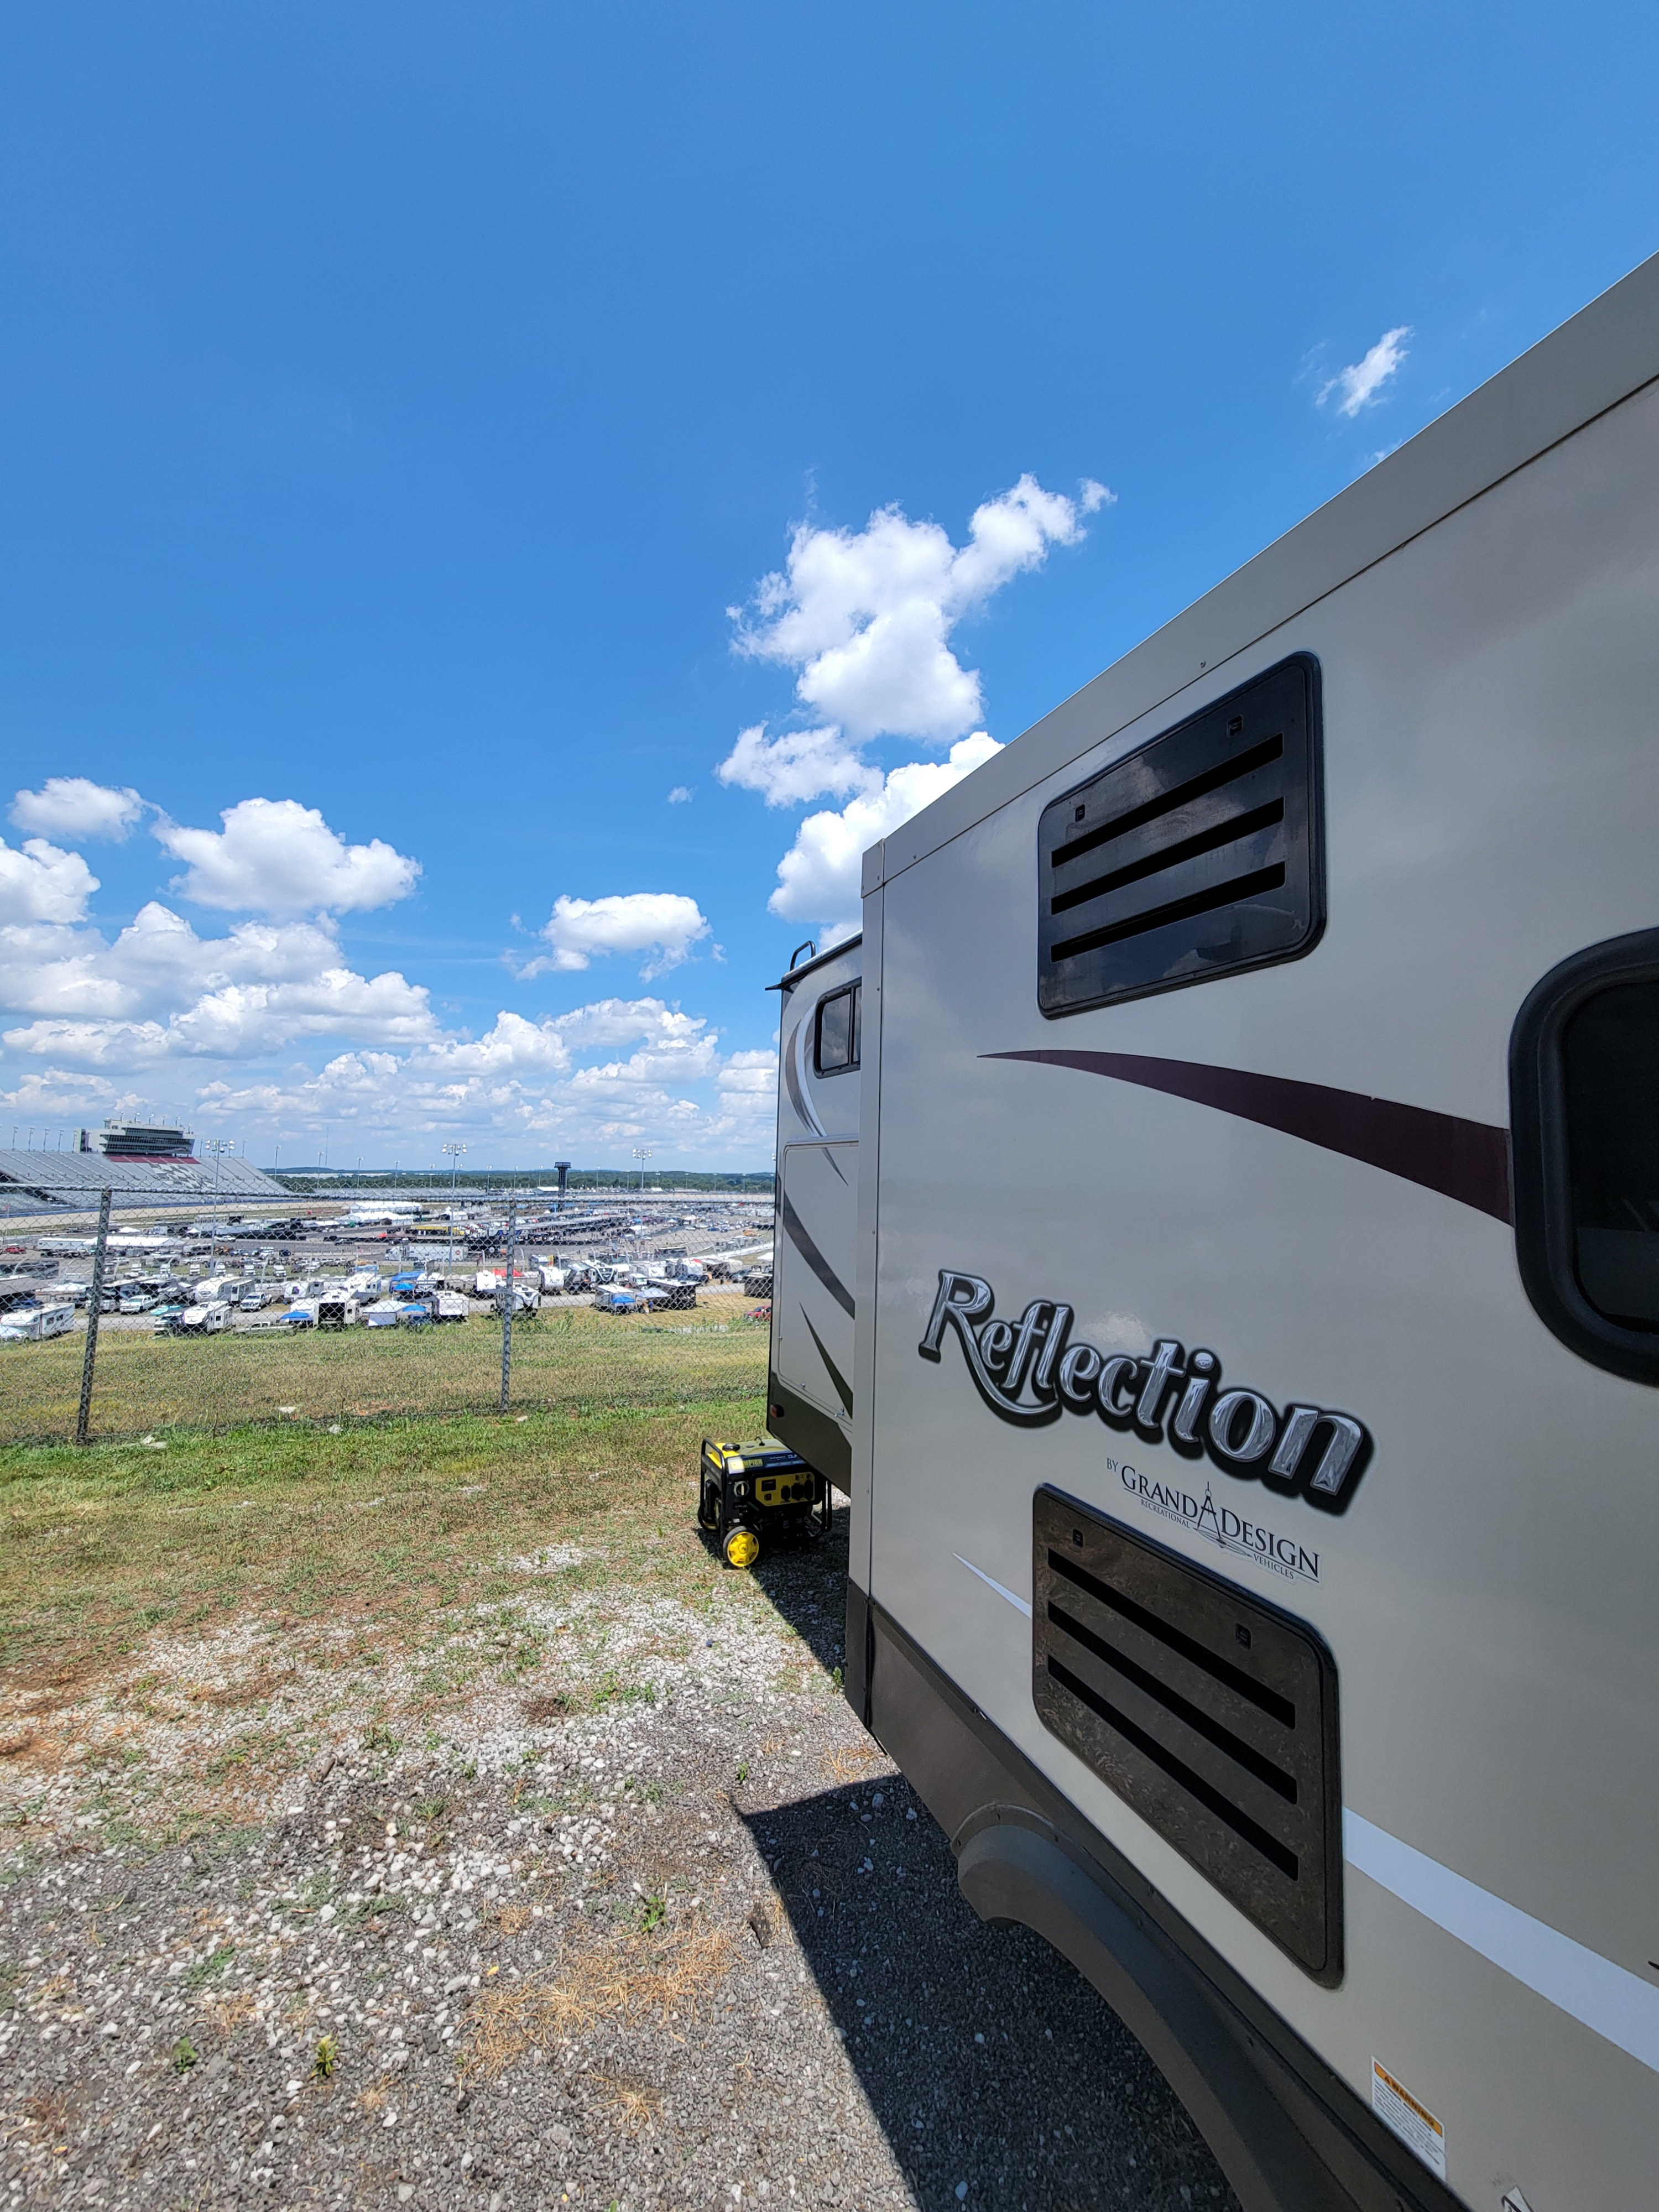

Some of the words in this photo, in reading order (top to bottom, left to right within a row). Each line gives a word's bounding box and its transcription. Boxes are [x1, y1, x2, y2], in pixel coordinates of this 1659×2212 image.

[919, 1269, 1374, 1516] Reflection
[1107, 1458, 1119, 1472] BY
[1121, 1465, 1198, 1518] GRAND
[1220, 1506, 1320, 1578] DESIGN
[1141, 1499, 1191, 1528] RECREATIONAL
[1254, 1553, 1294, 1579] VEHICLES
